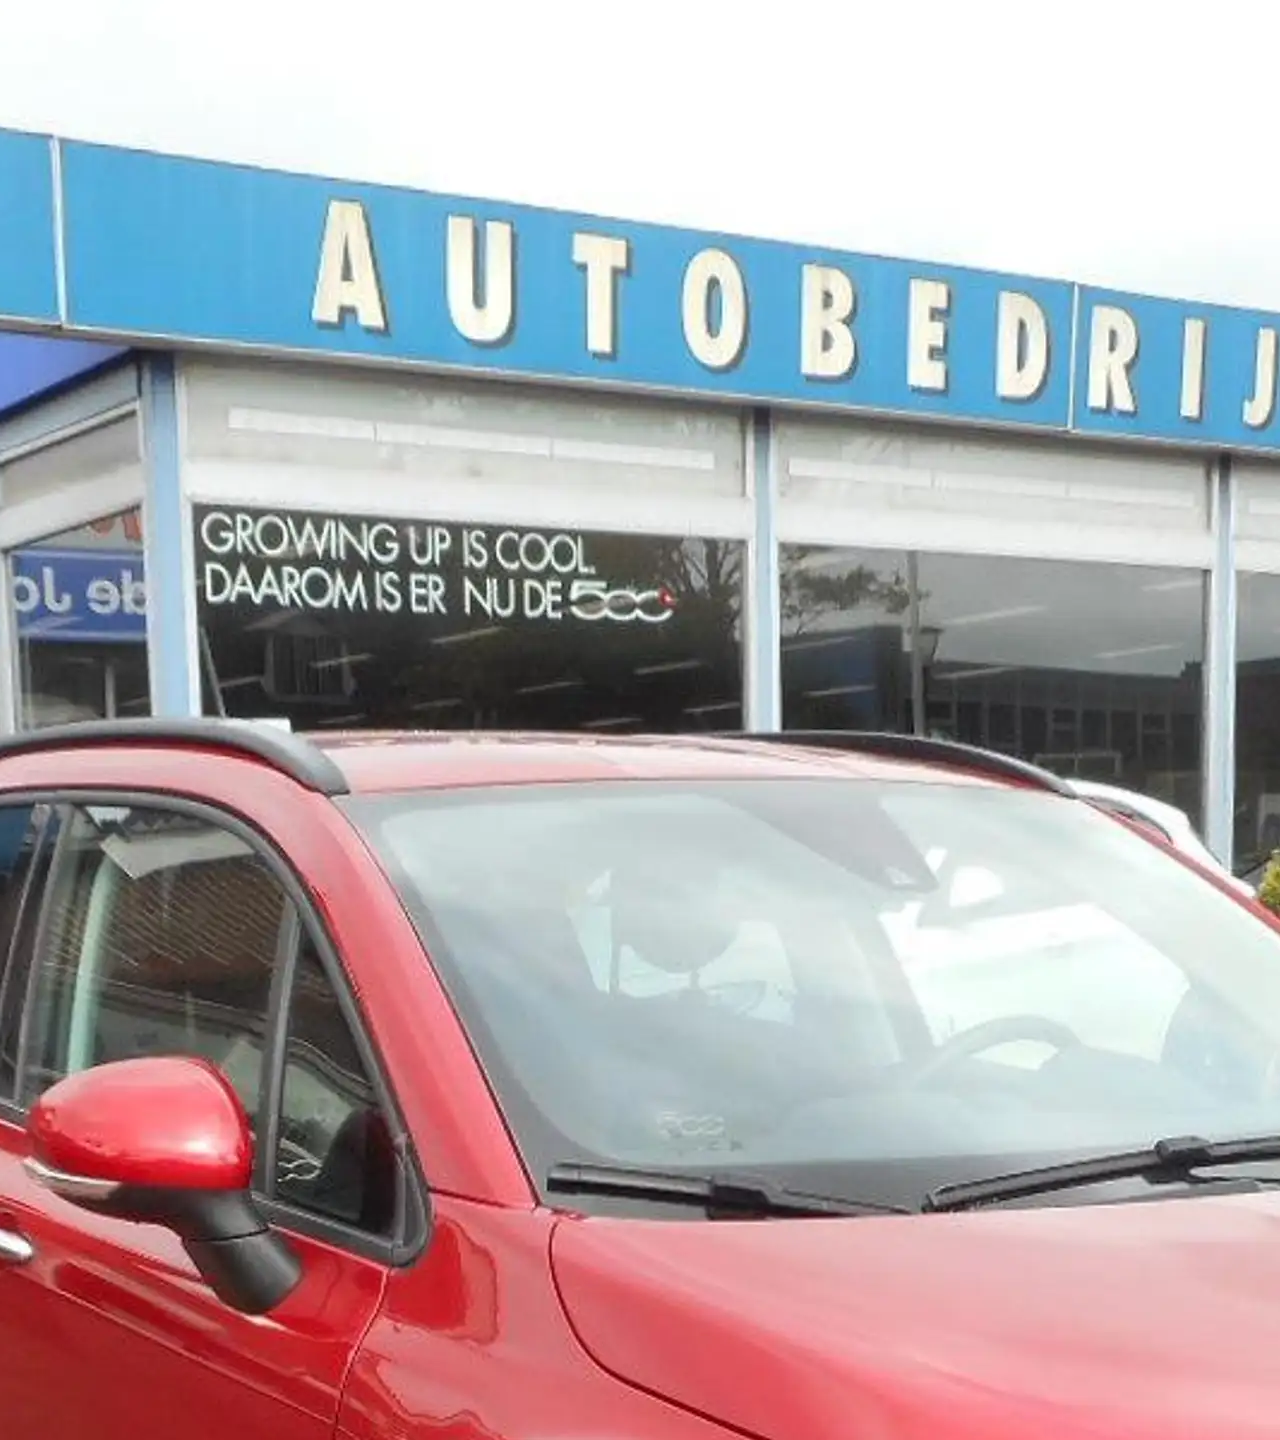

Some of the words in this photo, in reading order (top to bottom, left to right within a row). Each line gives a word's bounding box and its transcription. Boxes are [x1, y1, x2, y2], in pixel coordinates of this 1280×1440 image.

[201, 512, 399, 564] GROWING
[409, 526, 451, 566] UP
[463, 528, 488, 570] IS
[495, 532, 596, 575] COOL.
[204, 562, 367, 610] DAAROM
[375, 572, 402, 613] IS
[410, 575, 446, 616] ER
[464, 576, 515, 620] NU
[524, 579, 562, 620] DE
